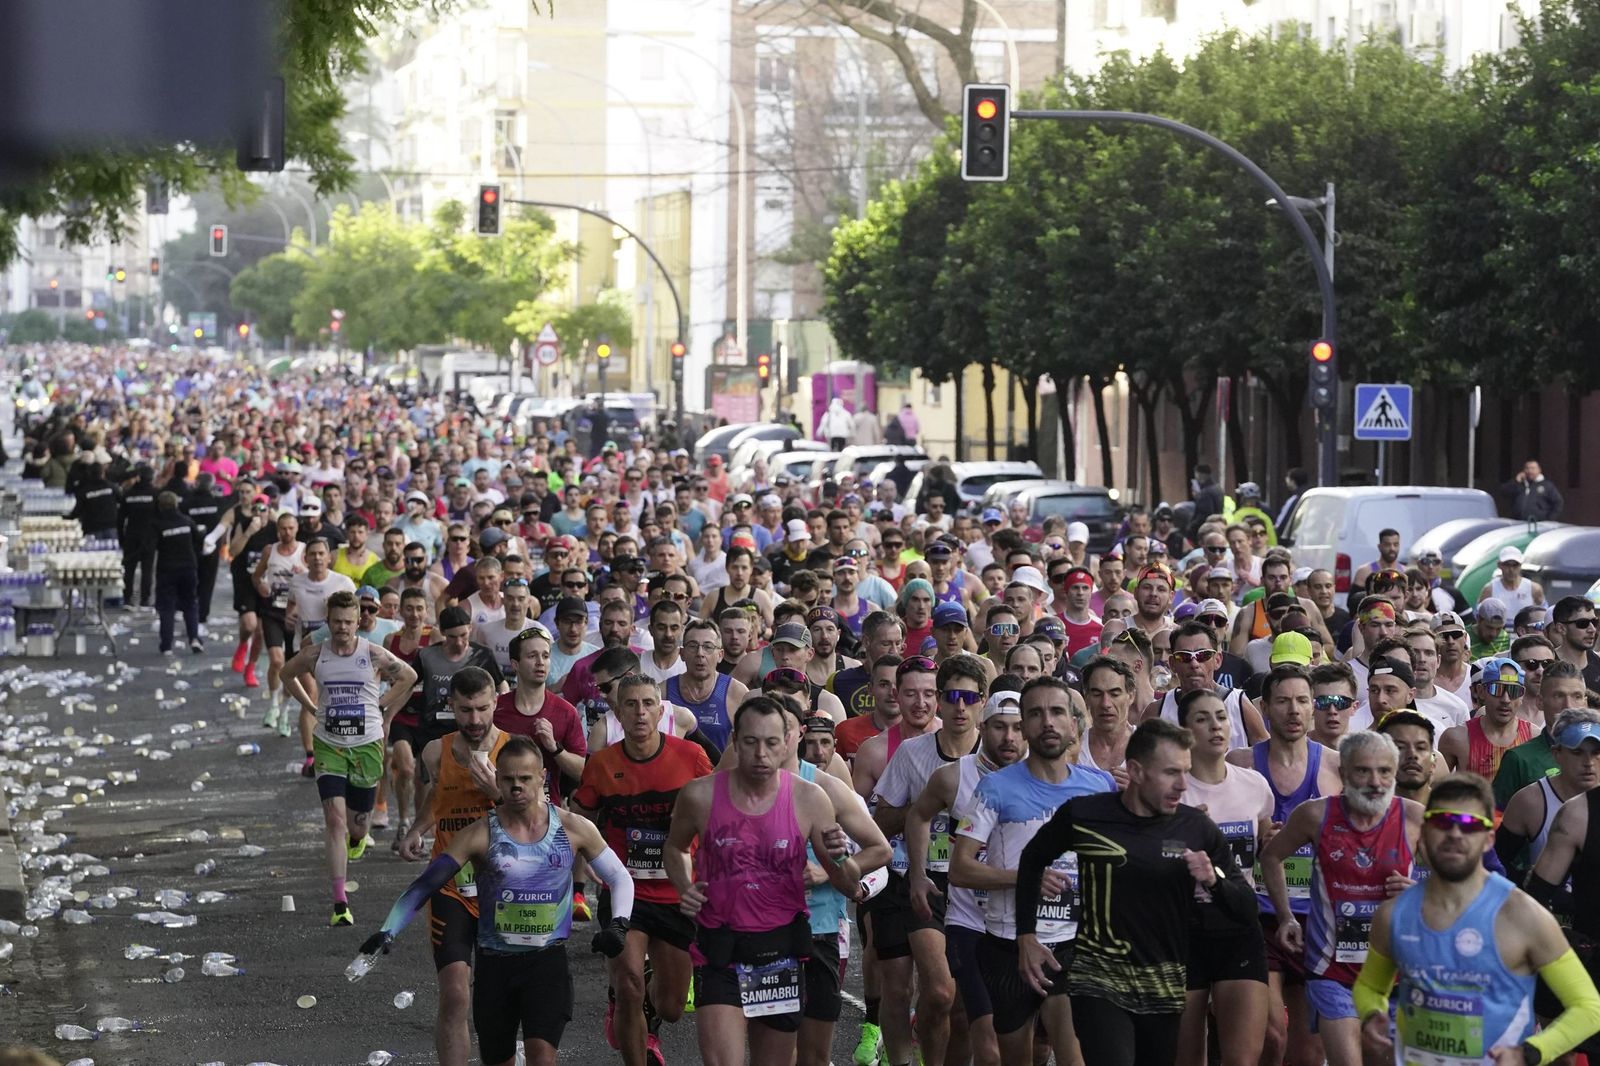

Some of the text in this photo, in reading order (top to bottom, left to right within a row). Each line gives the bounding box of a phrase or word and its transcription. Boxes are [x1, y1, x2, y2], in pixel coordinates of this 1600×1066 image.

[332, 726, 358, 735] OLIVER
[645, 847, 661, 856] 4958
[518, 893, 552, 901] ZURICH
[504, 923, 511, 932] M
[514, 924, 554, 934] PEDREGAL
[762, 974, 780, 985] 4415
[740, 985, 799, 1004] SANMABRU
[1426, 996, 1473, 1012] ZURICH
[1416, 1032, 1468, 1055] GAVIRA
